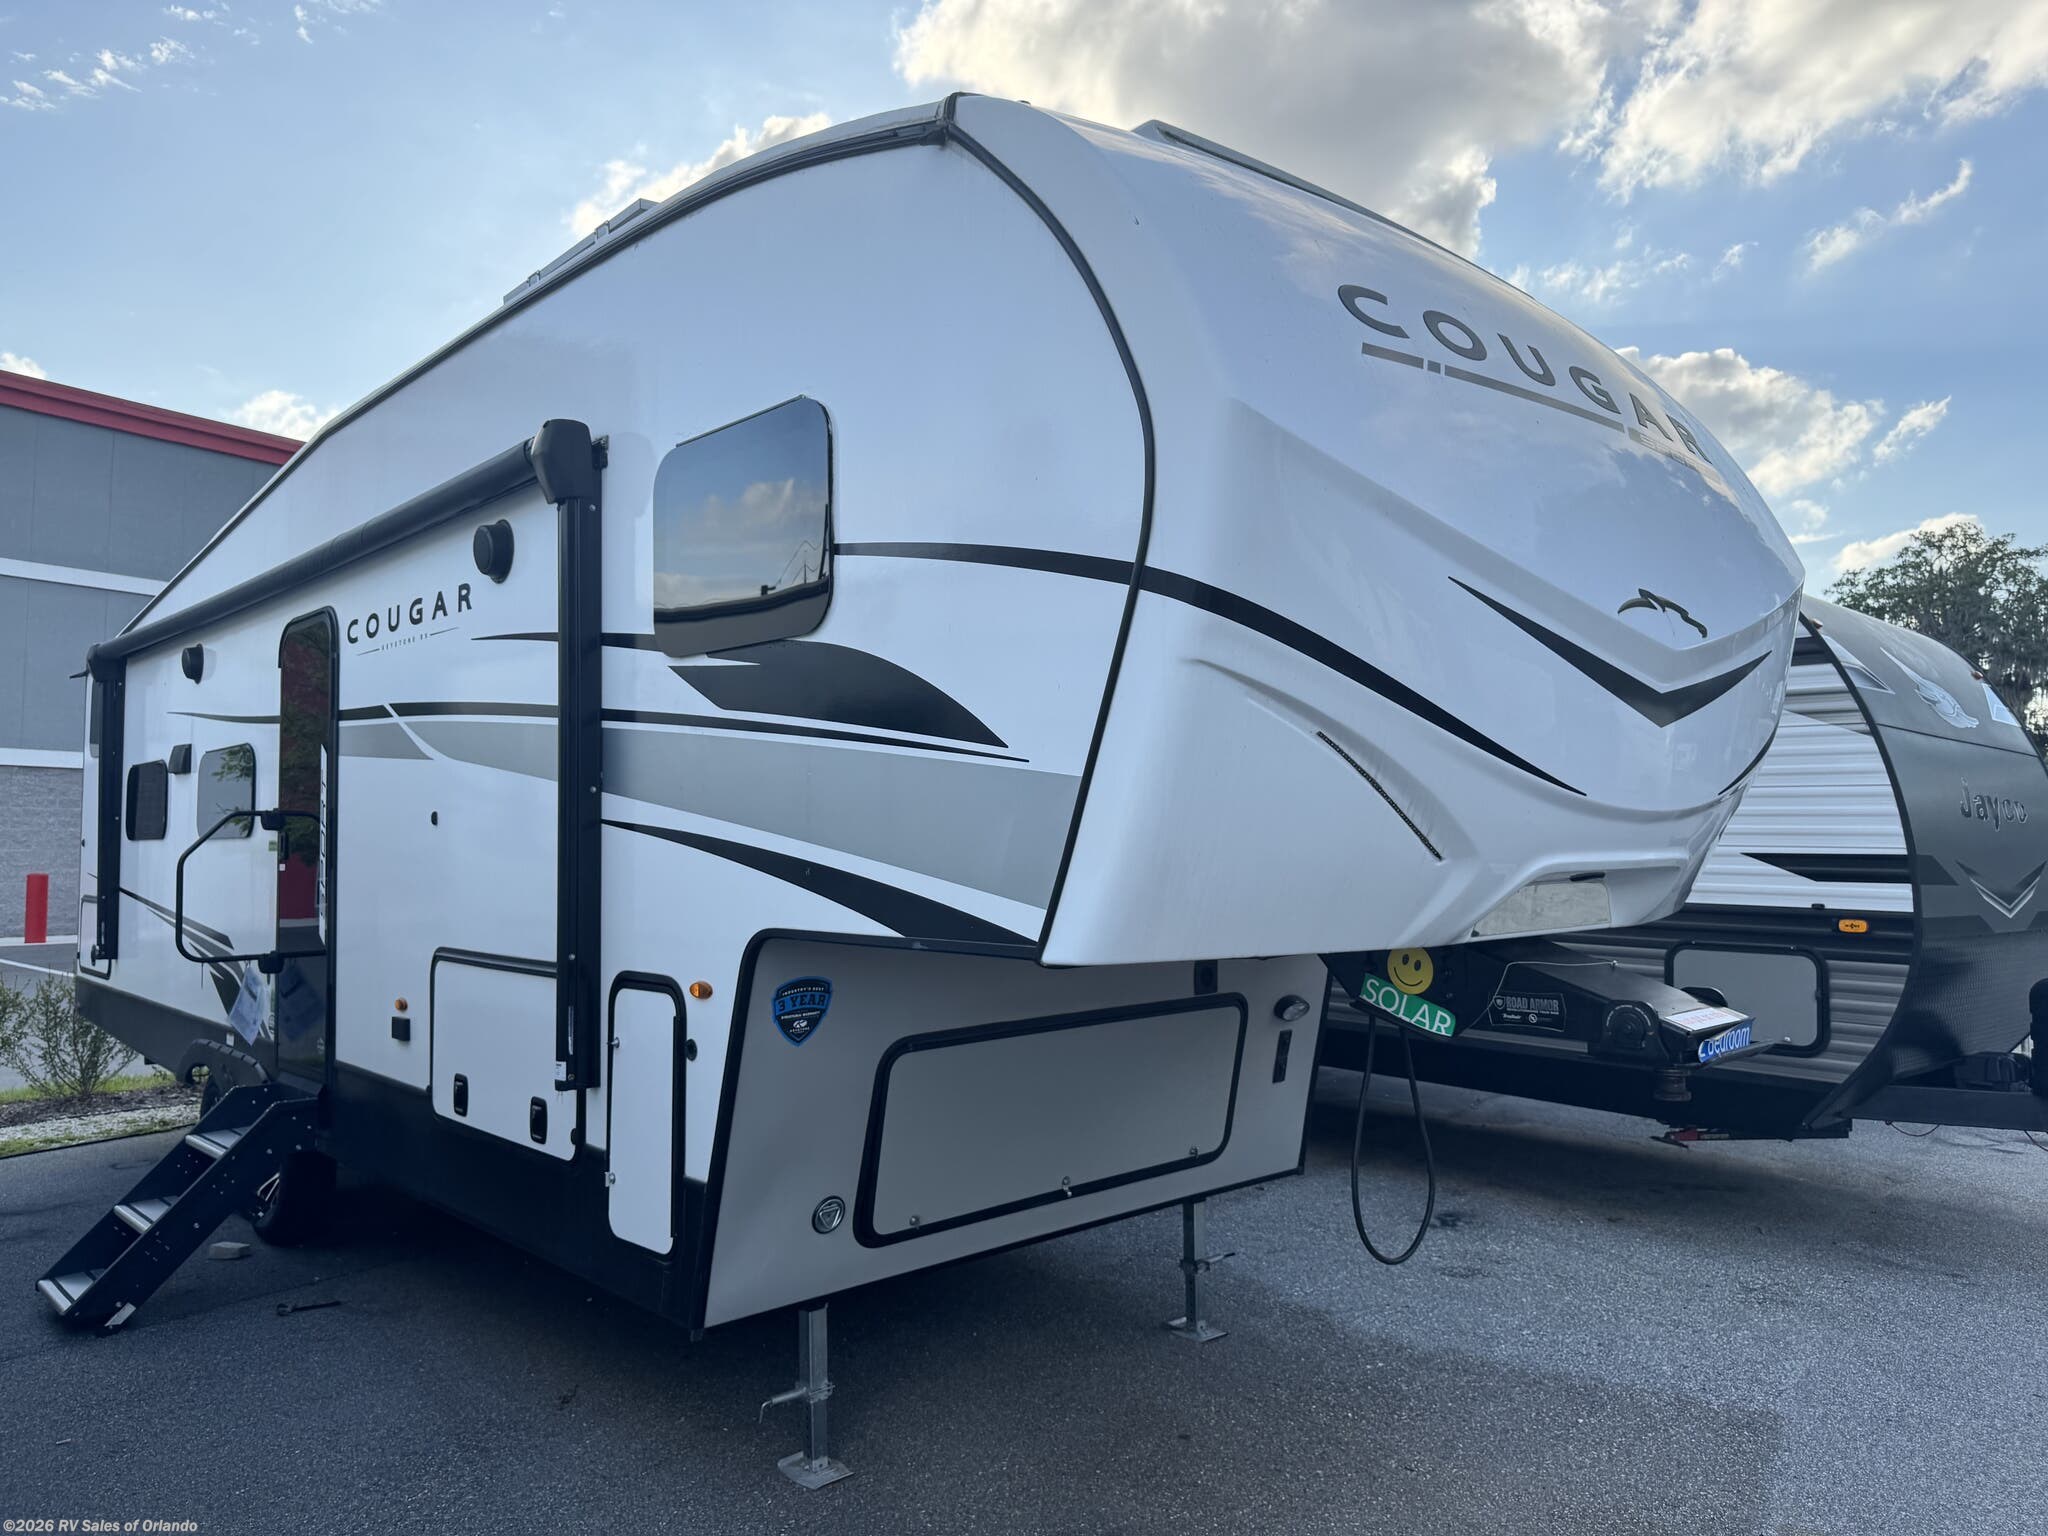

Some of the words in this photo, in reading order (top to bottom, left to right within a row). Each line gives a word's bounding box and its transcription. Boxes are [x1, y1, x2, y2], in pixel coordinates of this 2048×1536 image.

[1337, 283, 1714, 466] COUGAR
[347, 583, 472, 644] COUGAR
[1960, 776, 2028, 832] Jayco
[778, 1000, 786, 1011] 3
[790, 994, 825, 1007] YEAR
[1363, 978, 1452, 1036] SOLAR
[1506, 996, 1528, 1009] ROAD
[1529, 998, 1559, 1011] ARMOR
